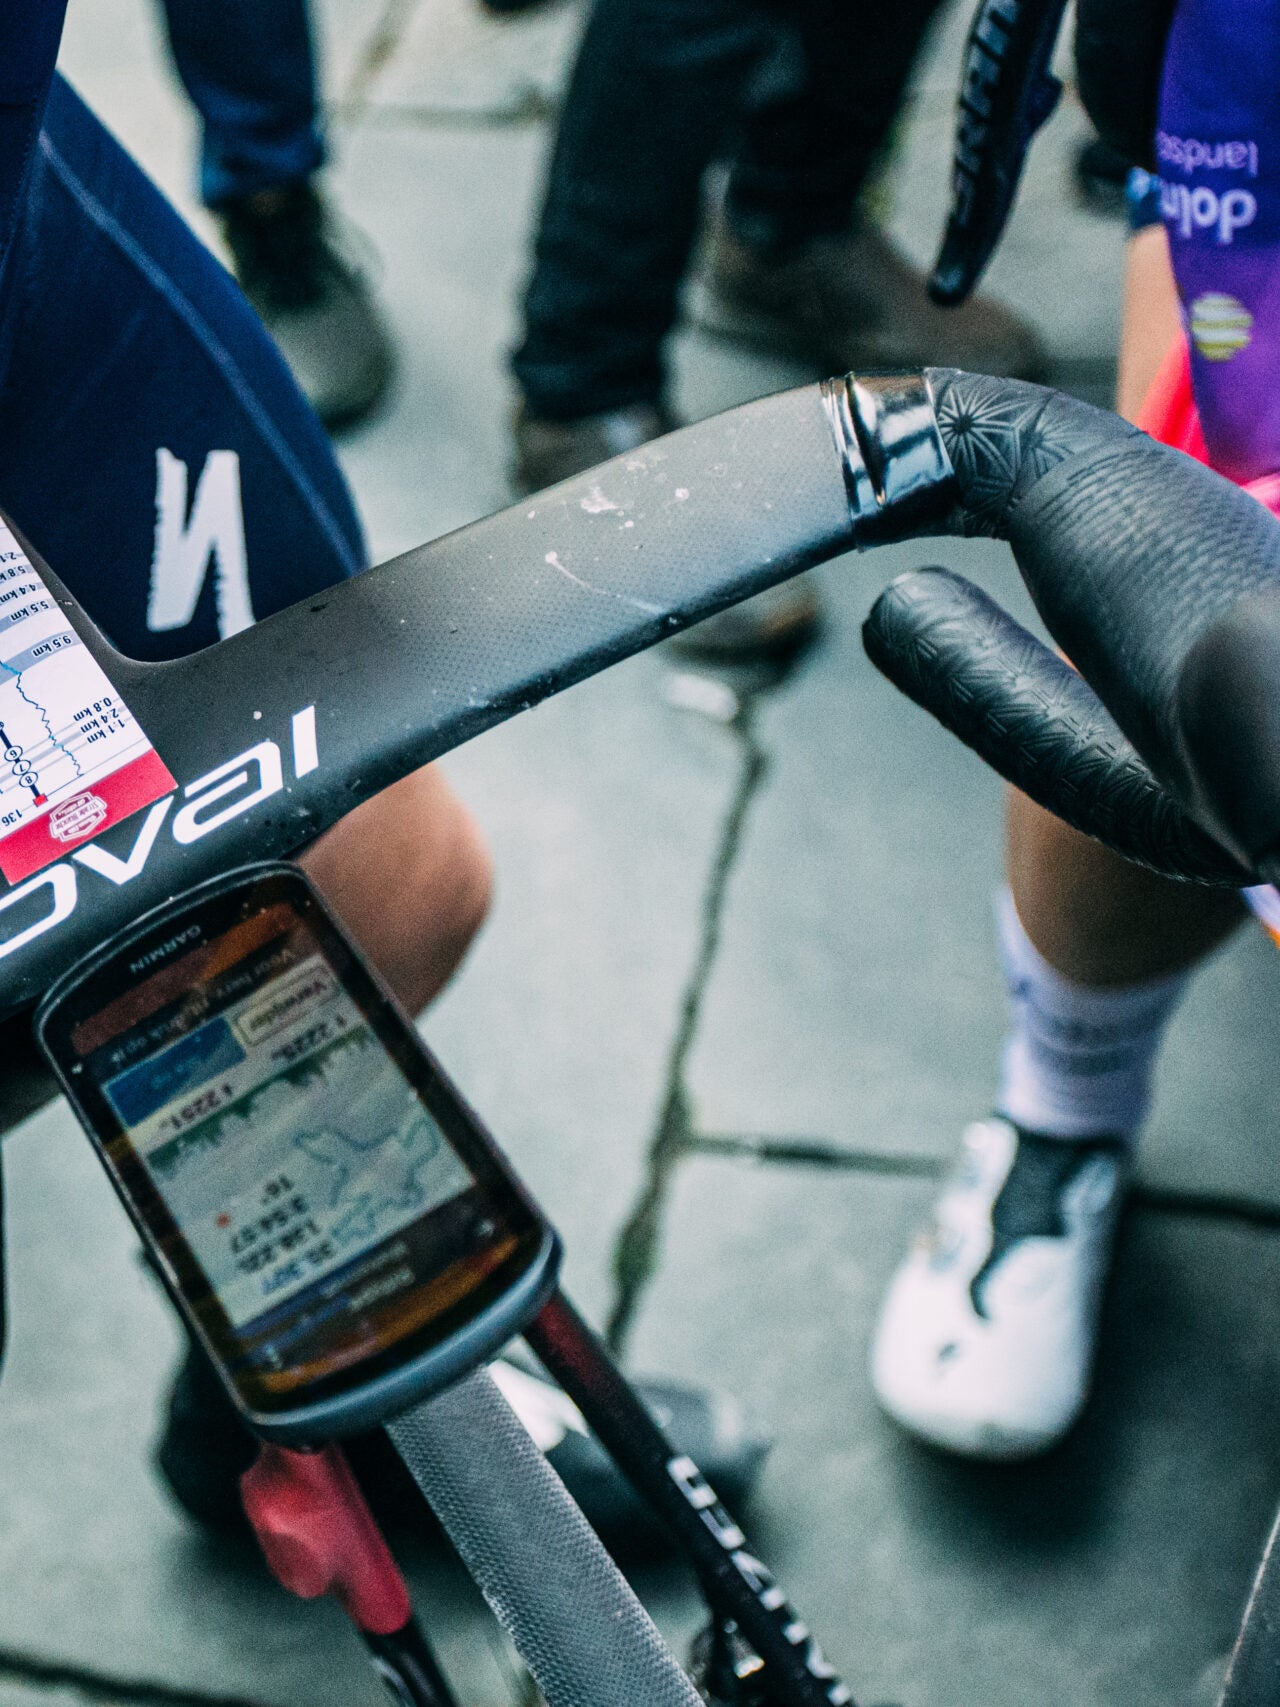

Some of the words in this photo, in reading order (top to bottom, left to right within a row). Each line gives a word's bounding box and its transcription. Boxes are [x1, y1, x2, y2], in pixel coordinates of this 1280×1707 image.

[0, 552, 16, 562] 2.1
[8, 566, 26, 577] 5.8
[19, 584, 36, 595] 4.4
[0, 590, 18, 602] km
[30, 601, 49, 612] 5.5
[11, 609, 29, 620] km
[53, 636, 71, 647] 9.5
[33, 644, 52, 656] km
[93, 698, 112, 712] 0.8
[74, 707, 92, 721] km
[101, 708, 119, 723] 2.4
[81, 719, 99, 733] km
[108, 719, 125, 734] 1.1
[87, 730, 106, 743] km
[130, 924, 201, 974] GARMIN
